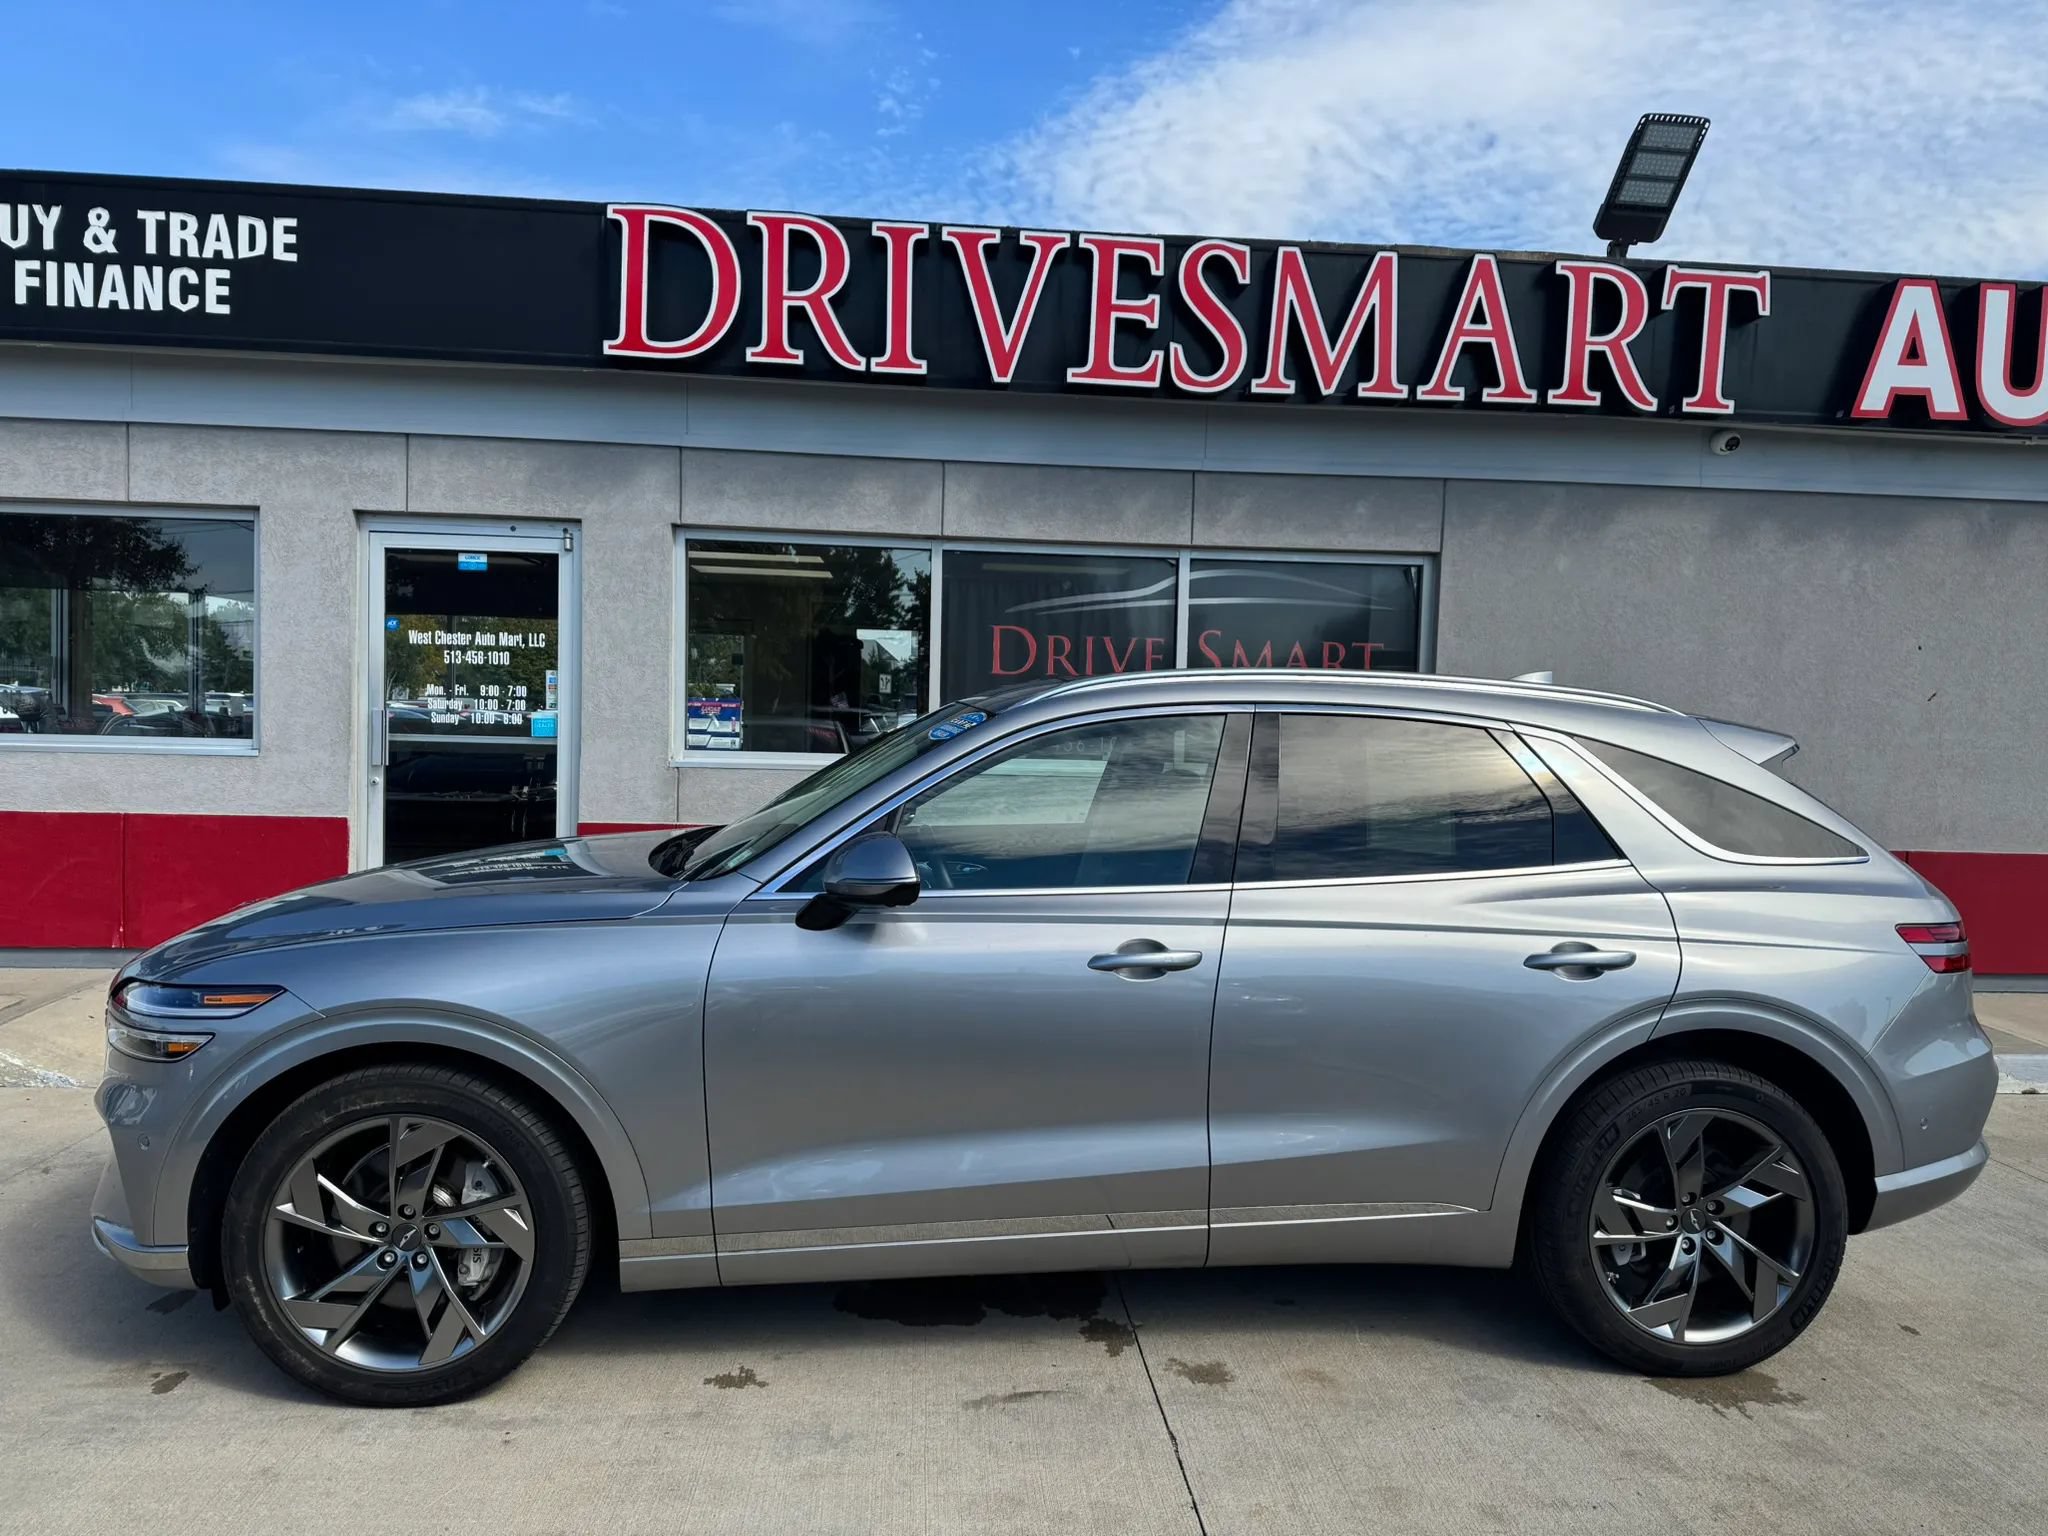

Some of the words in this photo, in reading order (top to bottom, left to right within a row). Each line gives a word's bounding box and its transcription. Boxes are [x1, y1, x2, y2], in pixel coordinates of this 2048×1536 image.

[0, 203, 62, 250] UY
[83, 206, 119, 254] &
[137, 209, 298, 263] TRADE
[14, 259, 231, 315] FINANCE
[603, 203, 1771, 415] DRIVESMART
[1851, 278, 2048, 427] AU
[408, 630, 432, 645] West
[435, 631, 472, 646] Chester
[475, 631, 496, 646] Auto
[499, 632, 525, 649] Mart,
[529, 633, 546, 648] LLC
[991, 625, 1166, 676] DRIVE
[1199, 630, 1384, 672] SMART
[426, 684, 447, 696] Mon.
[455, 684, 469, 696] Fri.
[480, 685, 500, 697] 9:00
[507, 685, 527, 697] 7:00
[428, 699, 462, 711] Saturday
[475, 699, 498, 710] 10:00
[506, 699, 526, 711] 7:00
[431, 712, 460, 725] Sunday
[471, 713, 495, 724] 10:00
